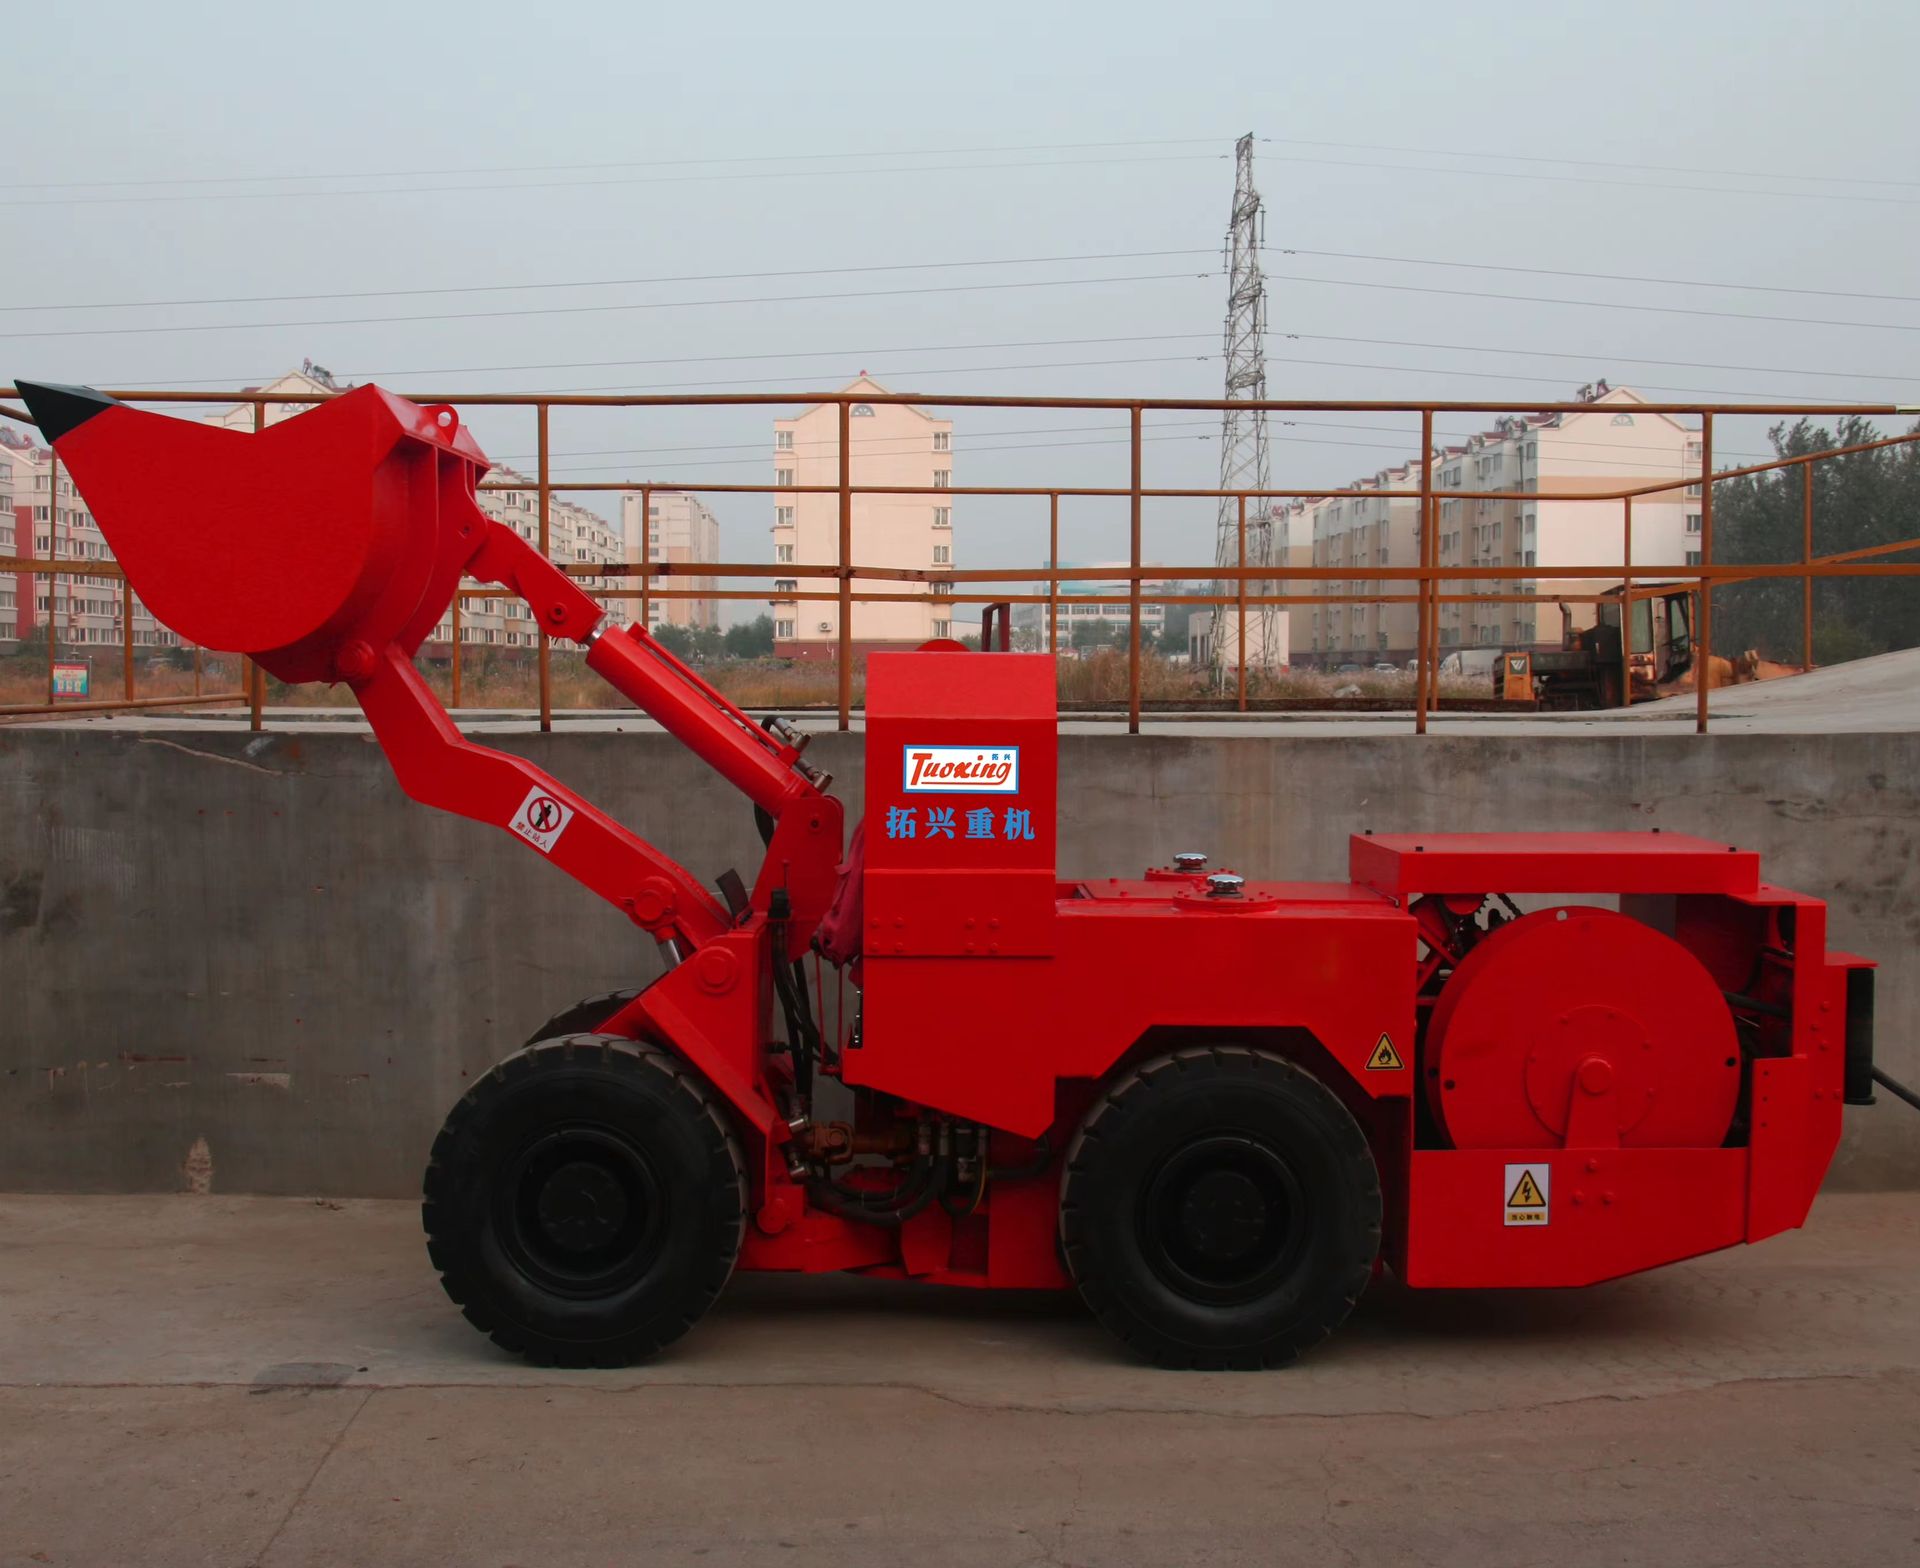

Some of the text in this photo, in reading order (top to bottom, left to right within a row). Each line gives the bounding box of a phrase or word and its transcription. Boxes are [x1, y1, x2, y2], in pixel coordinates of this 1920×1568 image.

[911, 753, 1011, 785] Tuoxing
[886, 805, 1035, 840] 拓兴重机
